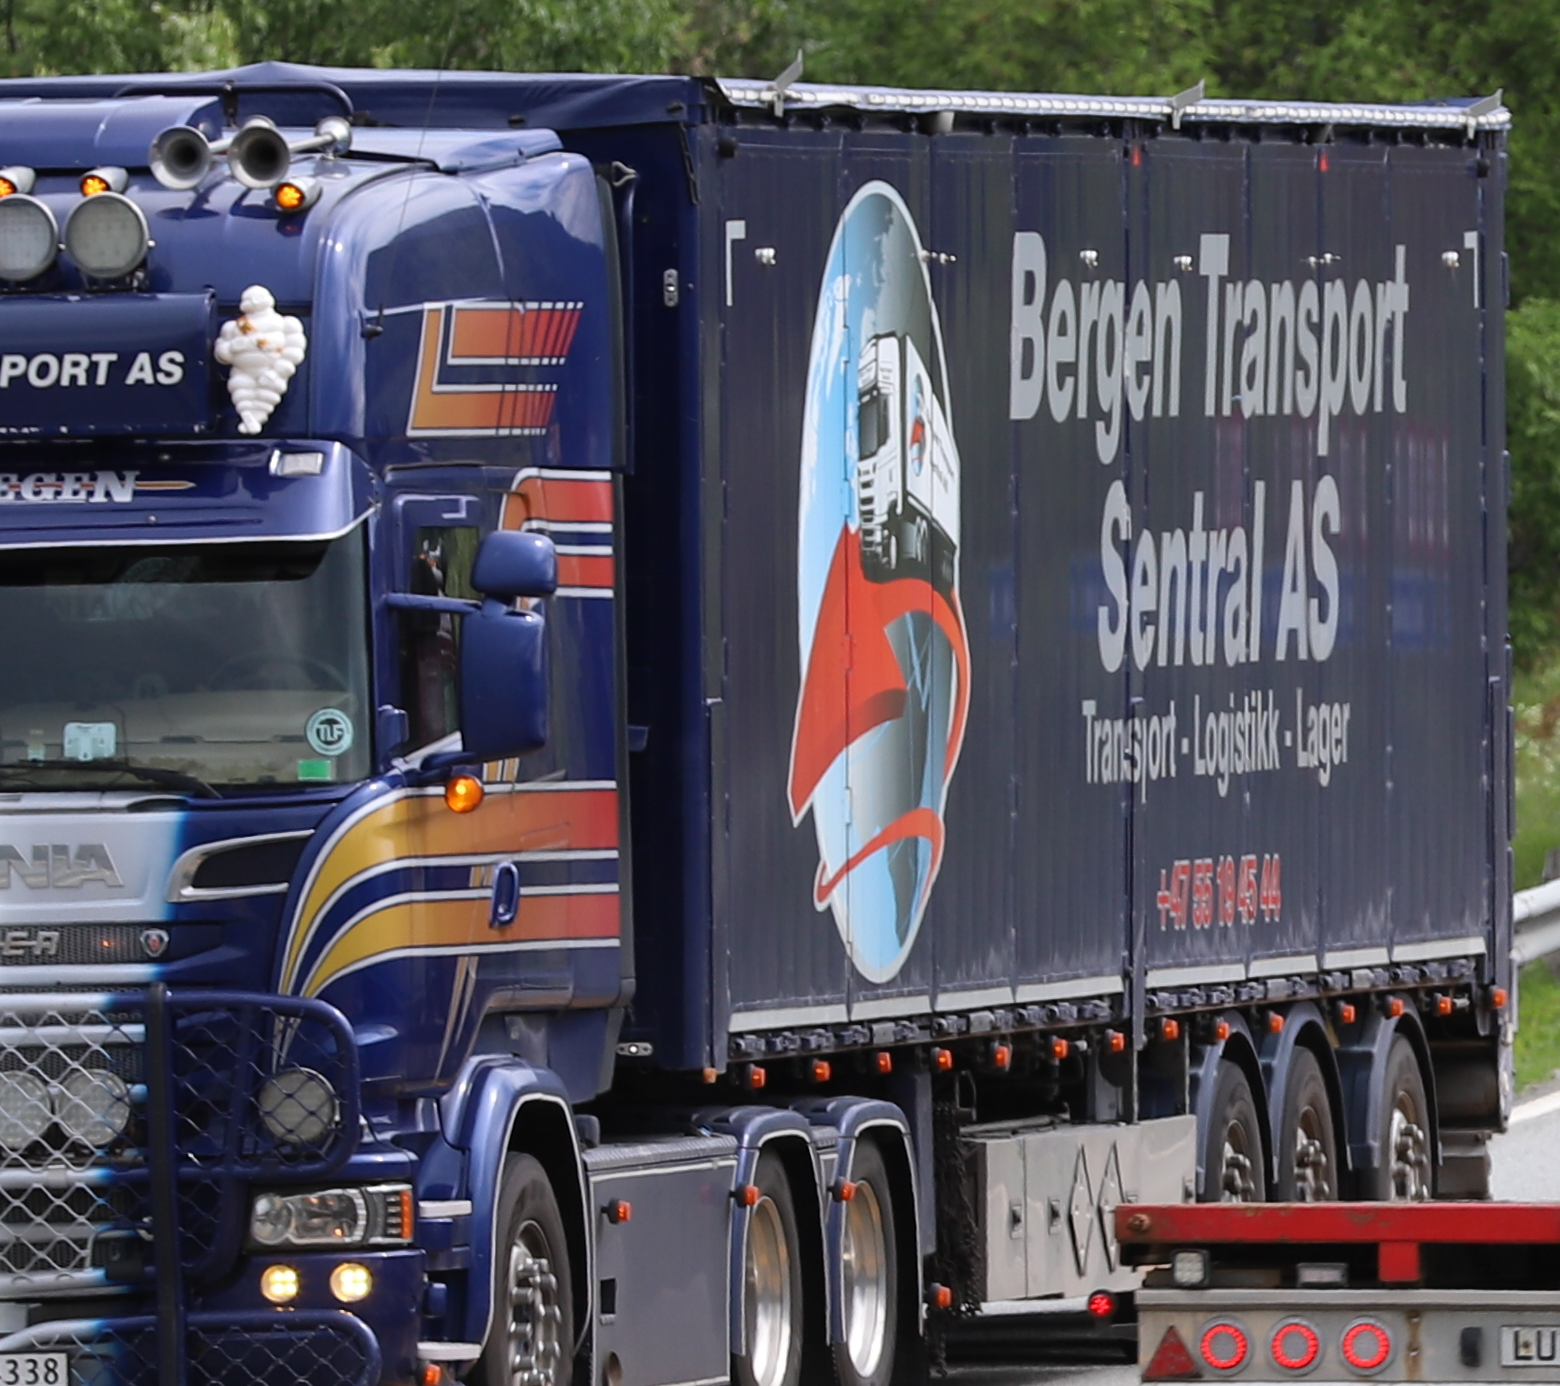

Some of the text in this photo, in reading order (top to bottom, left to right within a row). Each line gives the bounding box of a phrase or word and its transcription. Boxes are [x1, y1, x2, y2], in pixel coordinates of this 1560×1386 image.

[125, 351, 185, 387] AS
[1009, 231, 1409, 465] Bergen Transport
[1098, 474, 1341, 674] Sentral AS
[1194, 689, 1281, 798] Logistikk
[1296, 687, 1351, 787] Lager
[1157, 859, 1191, 932] +47
[1192, 857, 1213, 931] 55
[1260, 852, 1282, 925] 44
[1514, 1330, 1557, 1361] LU
